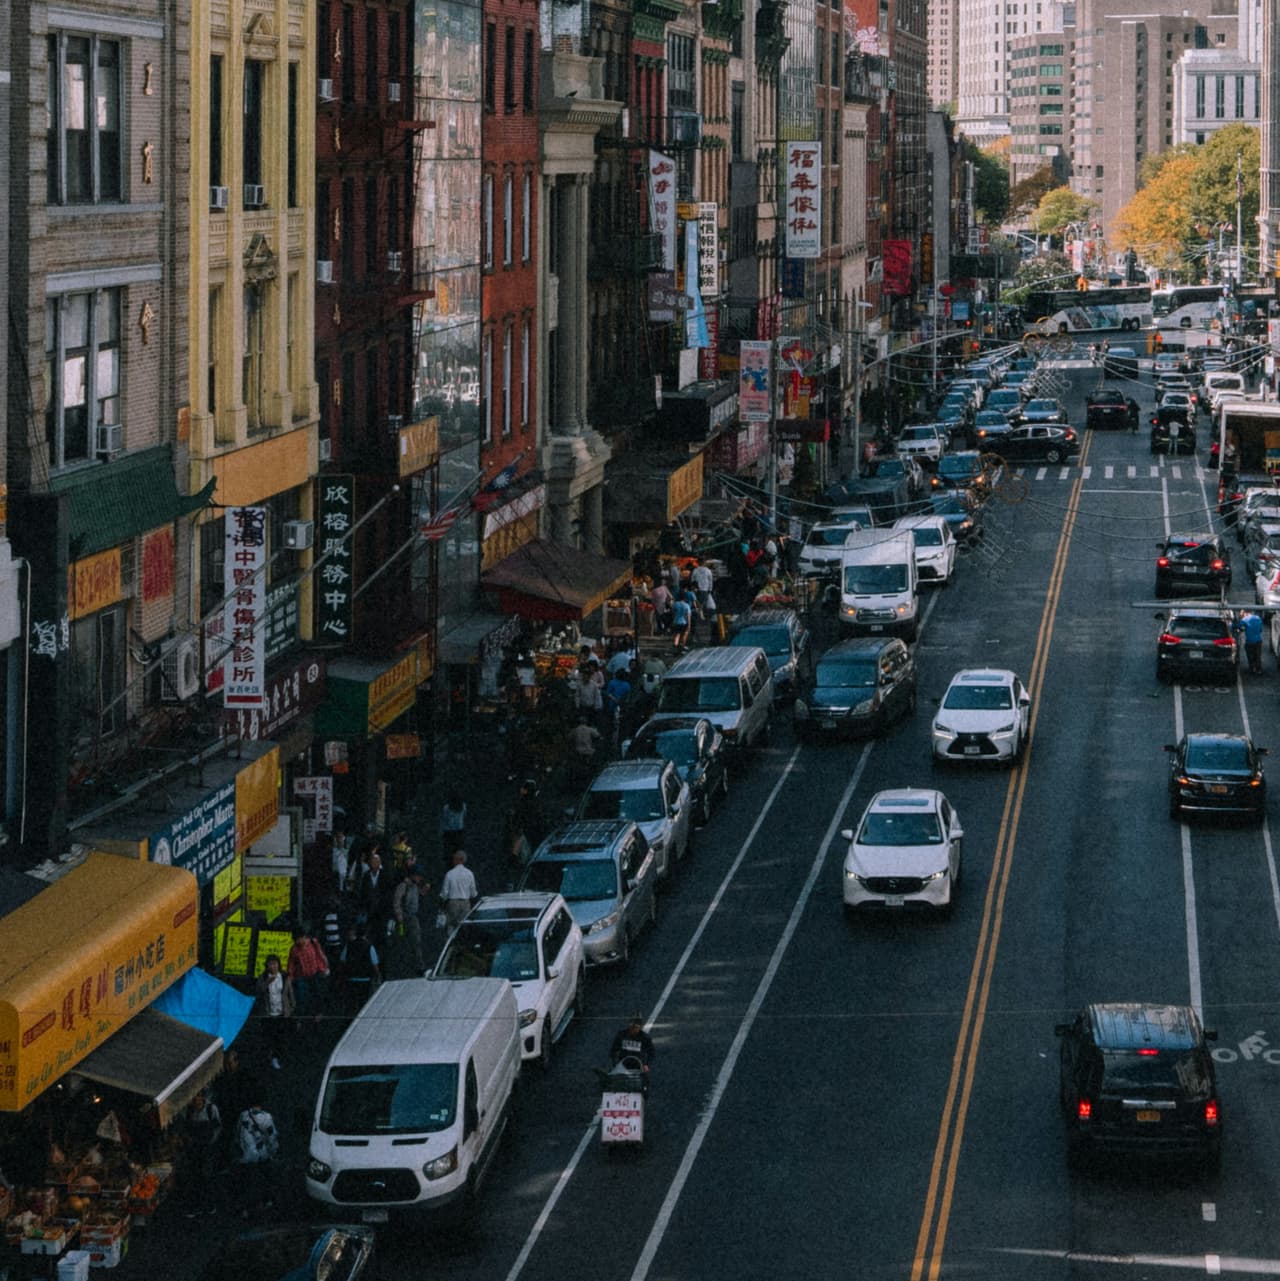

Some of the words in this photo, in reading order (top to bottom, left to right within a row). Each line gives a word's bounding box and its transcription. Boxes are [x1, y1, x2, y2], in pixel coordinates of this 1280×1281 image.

[322, 485, 350, 636] 欣榕服務中心
[173, 816, 214, 859] Christopher
